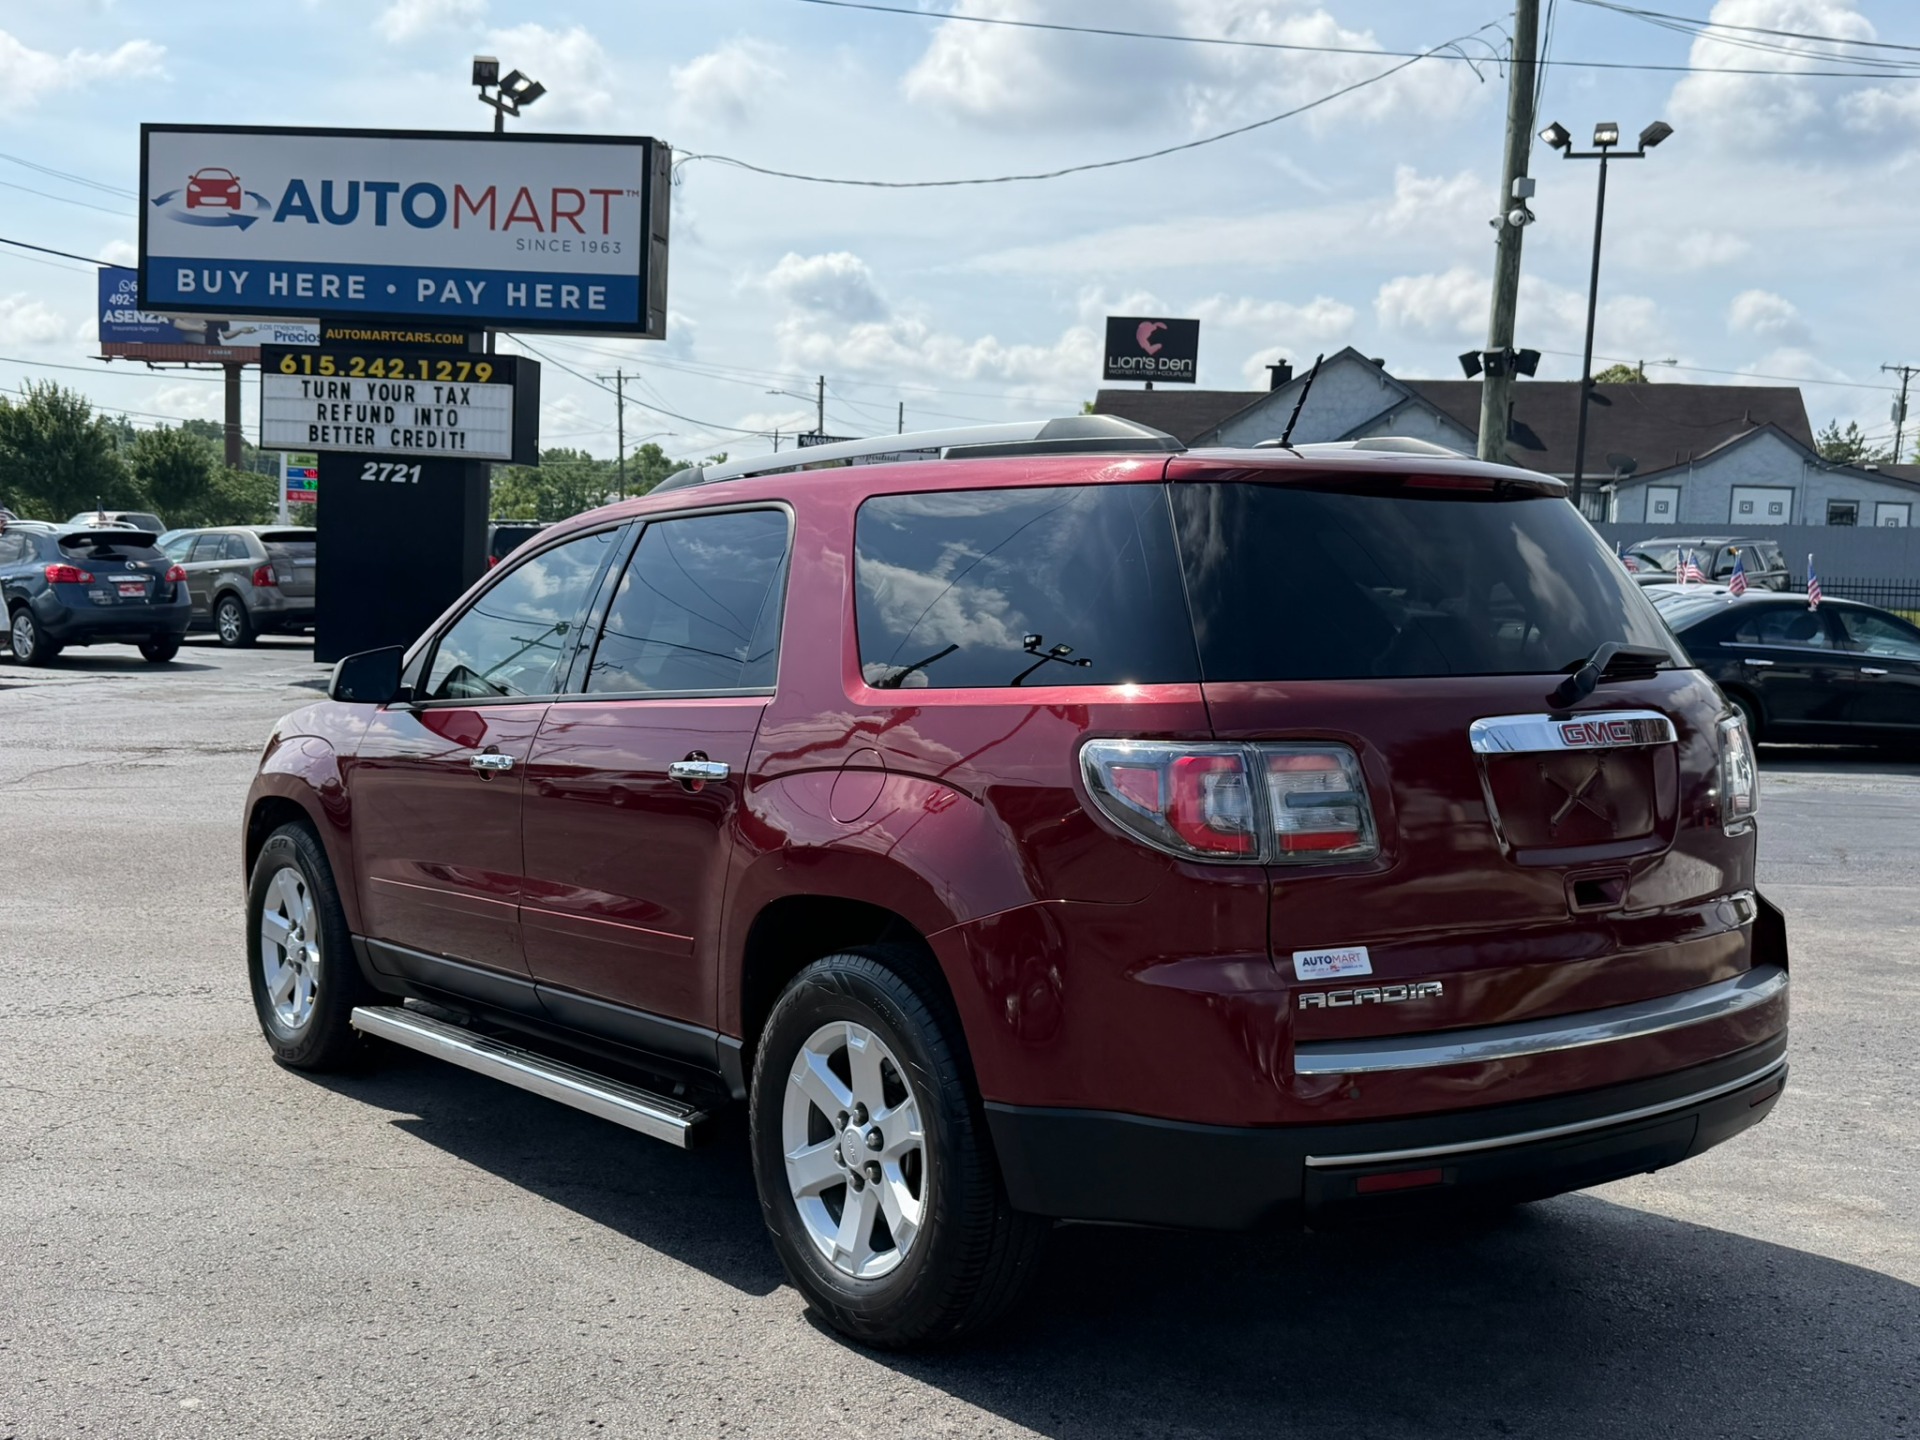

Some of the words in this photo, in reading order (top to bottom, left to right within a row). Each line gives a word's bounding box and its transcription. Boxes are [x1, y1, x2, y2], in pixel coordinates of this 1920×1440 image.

[272, 178, 623, 236] AUTOMART
[515, 238, 574, 253] SINCE
[580, 239, 622, 255] 1963
[177, 268, 250, 295] BUY
[268, 272, 366, 300] HERE
[417, 278, 488, 305] PAY
[506, 282, 607, 310] HERE
[325, 328, 464, 345] AUTOMARTCARS.COM
[279, 353, 493, 383] 615.242.1279
[301, 379, 351, 400] TURN
[367, 382, 416, 403] YOUR
[433, 386, 471, 405] TAX
[317, 403, 395, 424] REFUND
[414, 407, 459, 427] INTO
[308, 425, 375, 446] BETTER
[390, 428, 466, 450] CREDIT!
[360, 461, 422, 484] 2721
[1559, 721, 1634, 747] GMC
[1302, 952, 1361, 966] AUTOMART
[1298, 980, 1444, 1010] ACADIA
